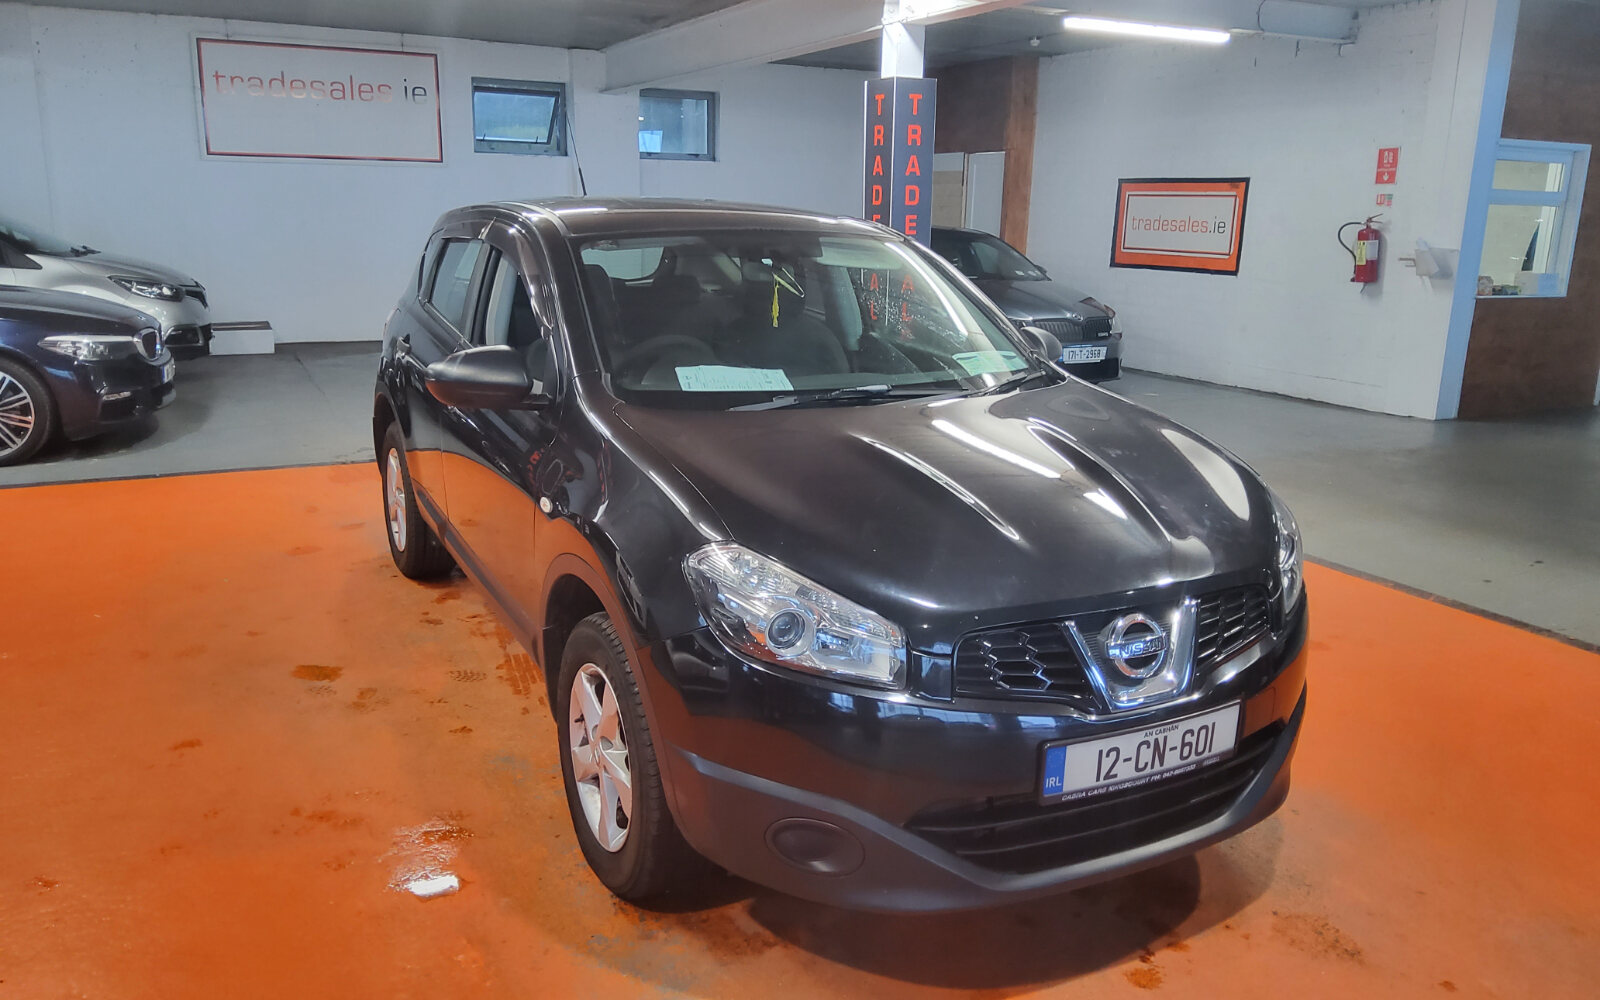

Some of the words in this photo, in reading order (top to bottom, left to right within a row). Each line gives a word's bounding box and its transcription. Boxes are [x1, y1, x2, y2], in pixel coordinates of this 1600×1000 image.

[905, 93, 922, 235] TRADE
[1132, 214, 1226, 234] tradesales.ie
[1095, 722, 1216, 782] 12-CN-601
[1045, 776, 1062, 788] IRL
